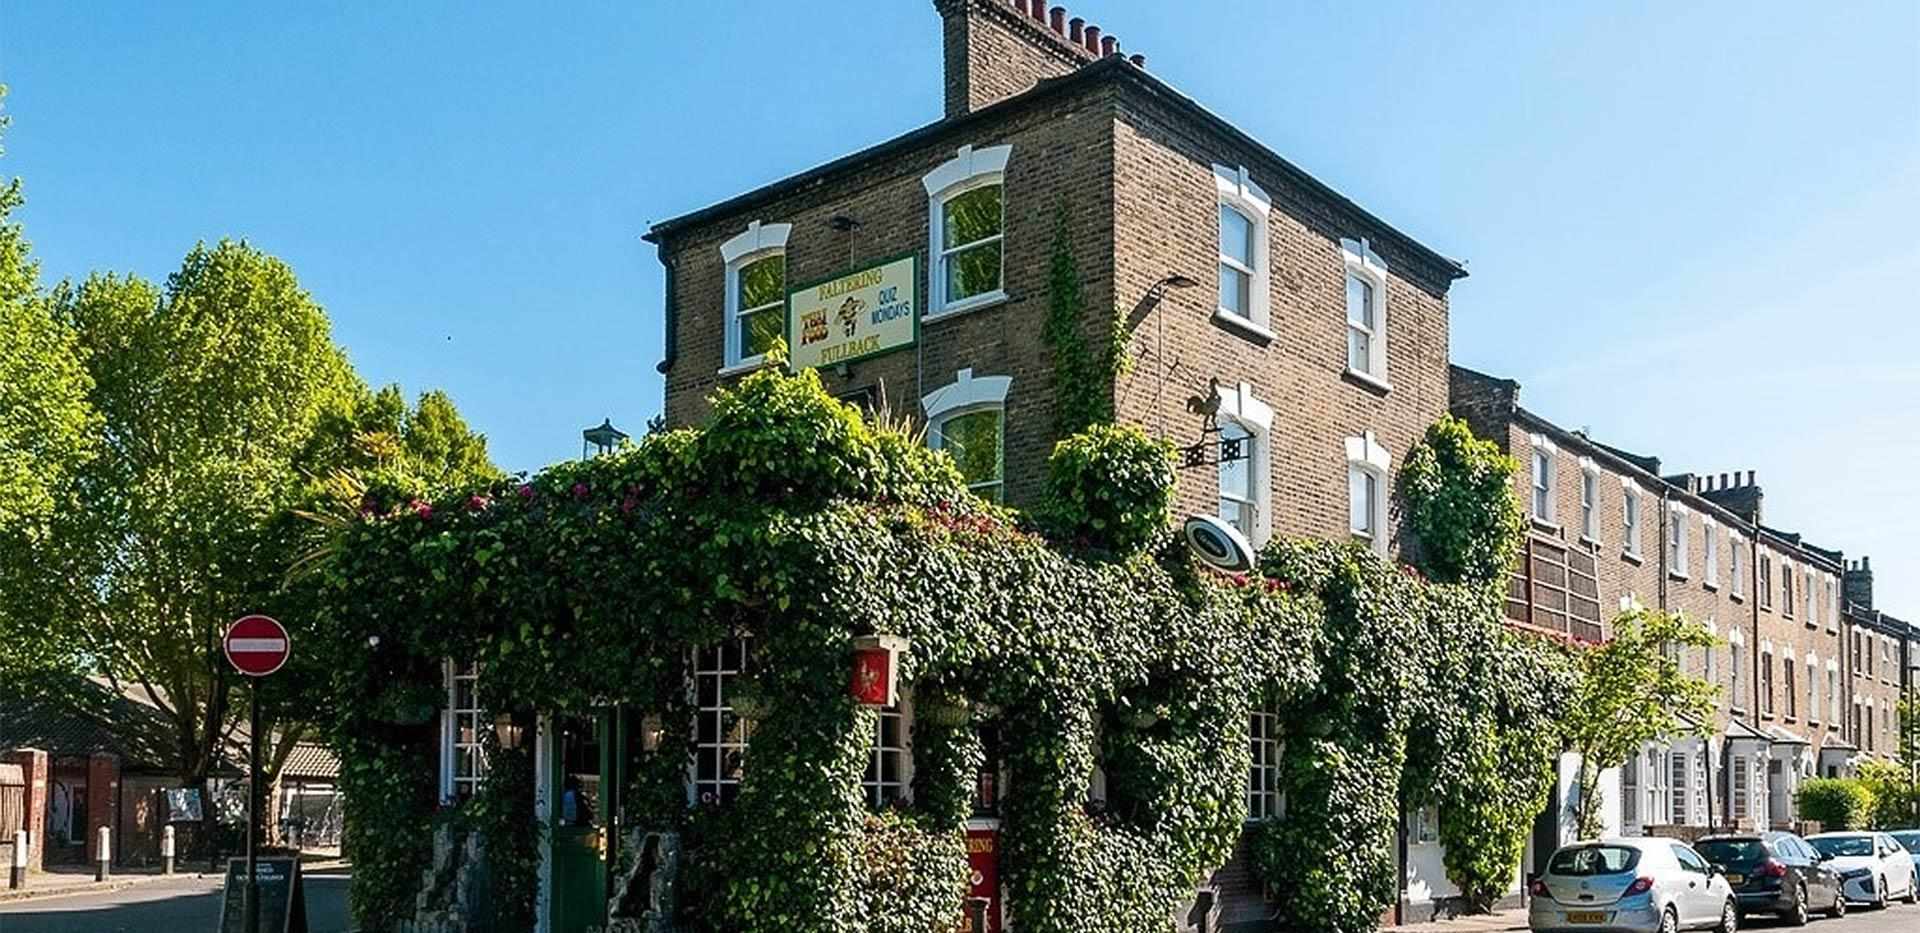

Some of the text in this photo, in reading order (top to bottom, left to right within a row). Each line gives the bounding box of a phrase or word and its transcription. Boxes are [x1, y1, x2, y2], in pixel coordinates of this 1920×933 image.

[818, 269, 883, 301] FALTERING
[879, 286, 897, 305] QUIZ
[871, 301, 911, 325] MONDAYS
[820, 334, 881, 361] FULLBACK
[967, 837, 993, 853] RING
